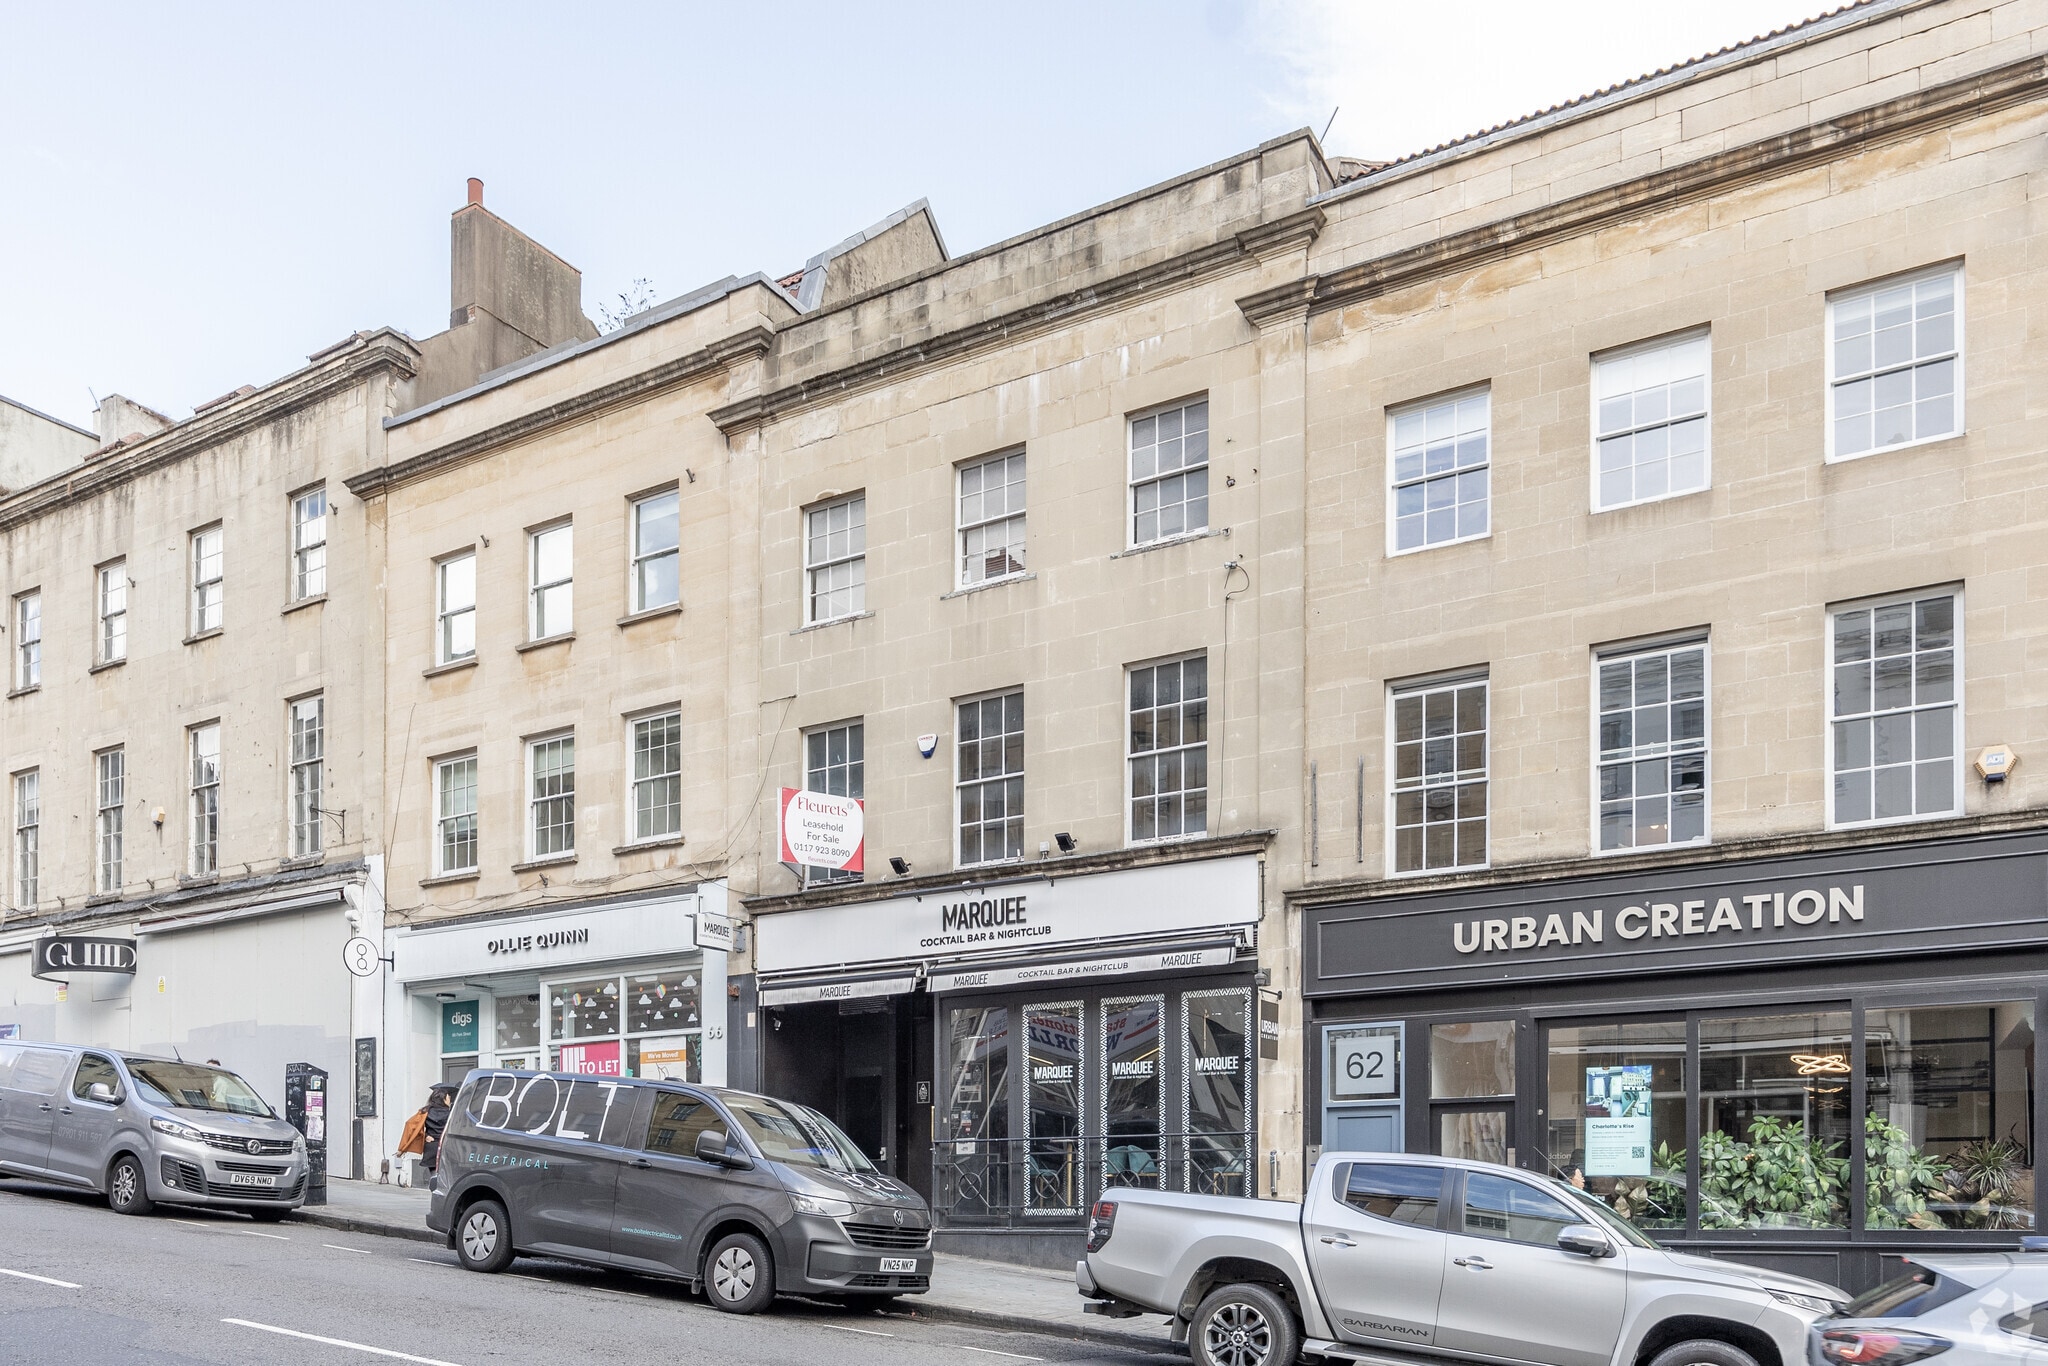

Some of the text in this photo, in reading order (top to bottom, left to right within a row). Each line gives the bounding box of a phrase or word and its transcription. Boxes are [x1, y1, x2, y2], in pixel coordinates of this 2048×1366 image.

[1986, 754, 2004, 765] ADT
[798, 796, 848, 817] Fleurets
[803, 818, 844, 833] Leasehold
[807, 831, 840, 844] For Sale
[794, 842, 851, 858] 0117 923 8090
[808, 856, 838, 865] fleurets.com
[942, 896, 1027, 932] MARQUEE
[1453, 885, 1865, 954] URBAN CREATION
[704, 922, 730, 938] MARQUEE
[920, 925, 1052, 947] COCKTAIL BAR & NIGHTCLUB
[487, 928, 589, 954] OLLIE QUINN
[1160, 952, 1203, 967] MARQUEE
[1017, 969, 1055, 979] COCKTAIL
[1057, 967, 1074, 975] BAR
[1083, 962, 1129, 973] NIGHTCLUB
[953, 973, 989, 987] MARQUEE
[819, 985, 851, 998] MARQUEE
[451, 1012, 472, 1027] digs
[1261, 1019, 1279, 1034] URBAN
[708, 1026, 723, 1039] 66
[580, 1059, 619, 1074] TO LET
[1112, 1061, 1154, 1076] MARQUEE
[1195, 1056, 1239, 1071] MARQUEE
[1346, 1051, 1384, 1079] 62
[1034, 1065, 1073, 1080] MARQUEE
[475, 1072, 634, 1142] BOLT
[468, 1153, 549, 1170] ELECTRICAL
[234, 1175, 255, 1184] DV69
[883, 1259, 914, 1270] VN25 NKP
[1342, 1317, 1429, 1337] BARBARIAN
